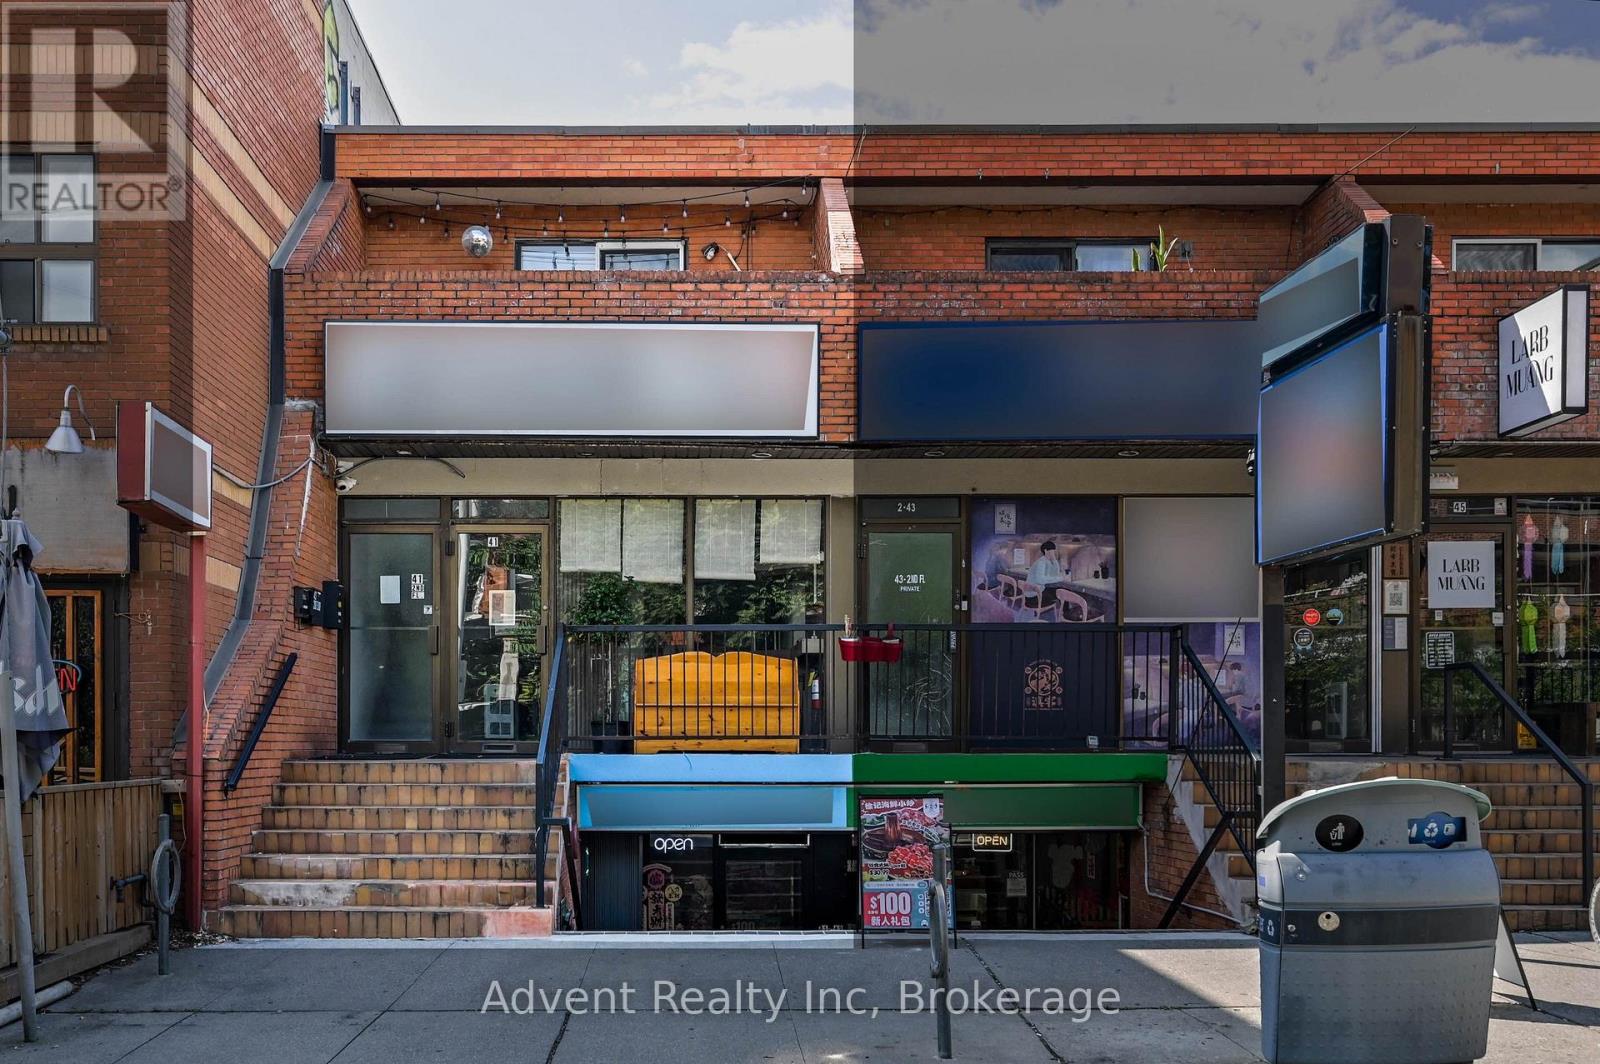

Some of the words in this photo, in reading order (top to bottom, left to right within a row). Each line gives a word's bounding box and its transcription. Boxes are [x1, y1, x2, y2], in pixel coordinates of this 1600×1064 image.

[1511, 324, 1549, 365] LARB
[1506, 355, 1554, 399] MUANG
[1454, 502, 1465, 512] 45
[488, 537, 498, 547] 41
[1442, 559, 1480, 573] LARB
[412, 574, 422, 584] 41
[1438, 575, 1485, 591] MUANG
[654, 838, 694, 853] open
[976, 836, 1008, 846] OPEN
[870, 892, 911, 914] $100
